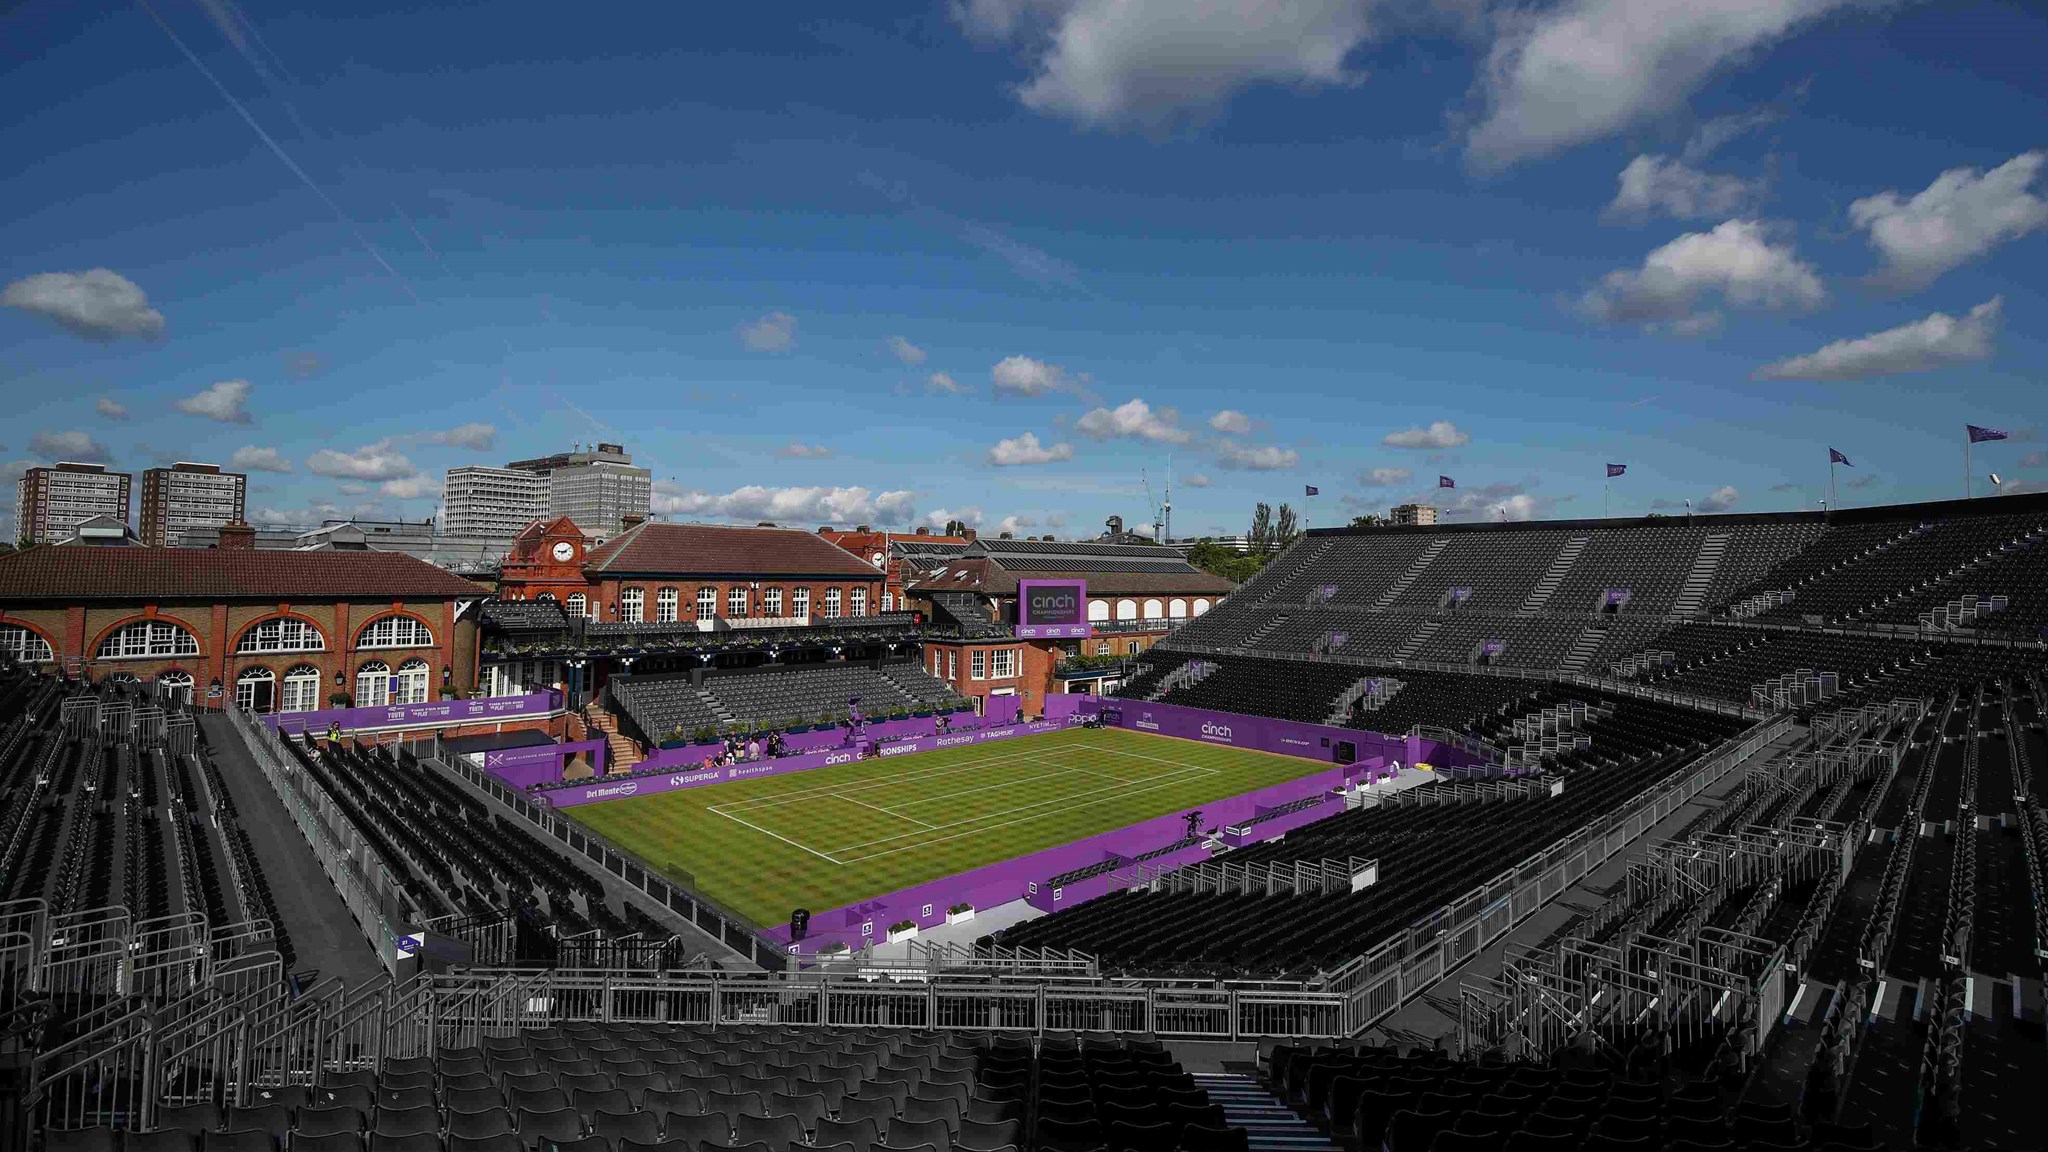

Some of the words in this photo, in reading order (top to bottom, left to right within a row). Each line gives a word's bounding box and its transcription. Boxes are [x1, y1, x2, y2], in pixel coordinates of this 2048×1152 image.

[1032, 594, 1075, 608] cinch
[387, 710, 405, 719] YOUTH
[468, 705, 484, 713] YOUTH
[1201, 720, 1232, 737] cinch
[937, 734, 974, 746] Rothesay
[825, 752, 850, 765] cinch
[737, 765, 773, 775] healthspan
[684, 772, 719, 783] SUPERGA
[586, 789, 598, 799] Del
[598, 787, 620, 797] Monte
